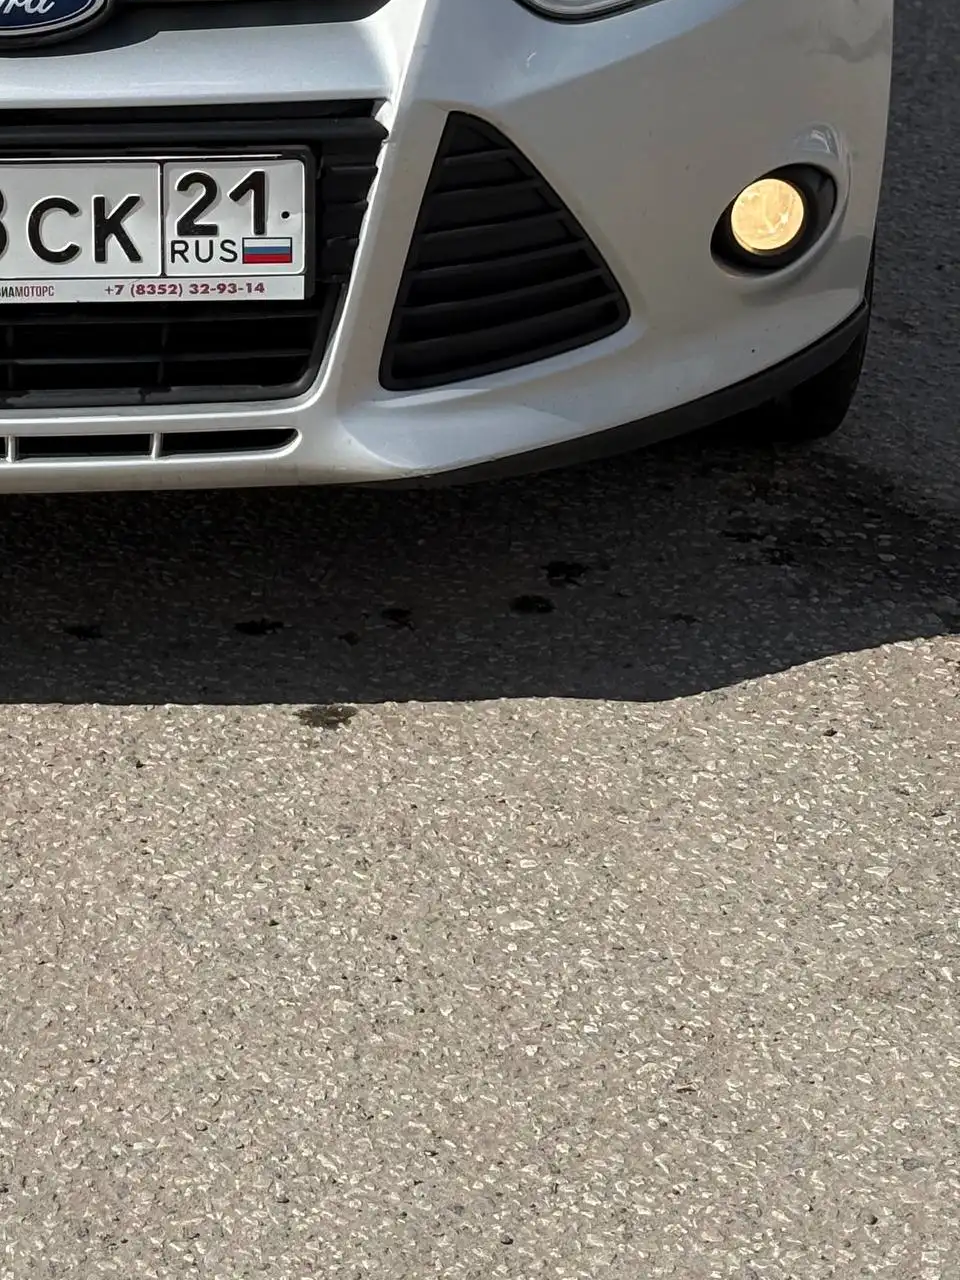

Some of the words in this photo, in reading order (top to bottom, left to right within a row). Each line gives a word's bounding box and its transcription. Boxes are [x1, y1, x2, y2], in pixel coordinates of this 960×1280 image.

[175, 170, 266, 237] 21
[170, 239, 238, 264] RUS
[130, 283, 183, 297] (8352)
[189, 282, 266, 295] 32-93-14
